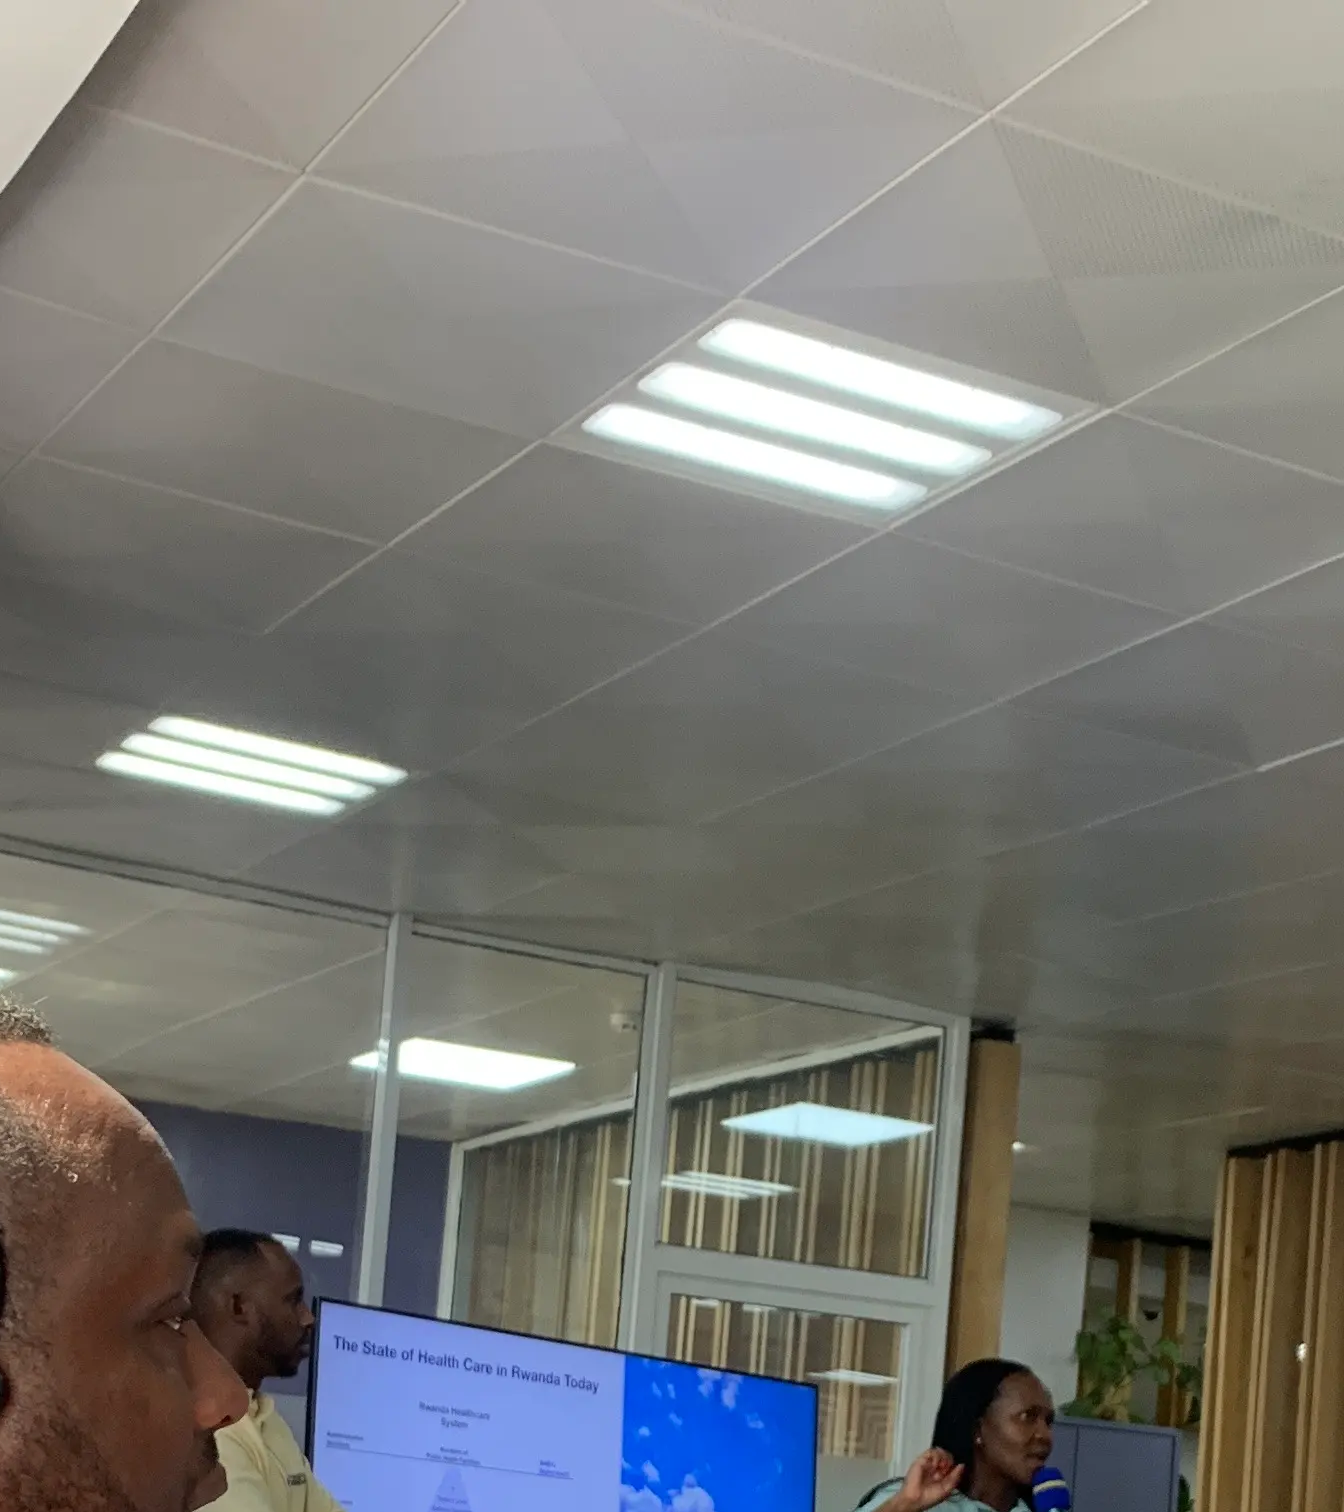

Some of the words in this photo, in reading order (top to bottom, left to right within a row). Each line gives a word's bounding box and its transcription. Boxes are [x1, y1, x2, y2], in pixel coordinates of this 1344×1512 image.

[333, 1334, 358, 1352] The
[362, 1340, 397, 1359] State
[401, 1348, 414, 1361] of
[418, 1350, 459, 1369] Health
[463, 1357, 492, 1375] Care
[496, 1363, 508, 1377] in
[511, 1365, 561, 1386] Rwanda
[564, 1373, 600, 1394] Today
